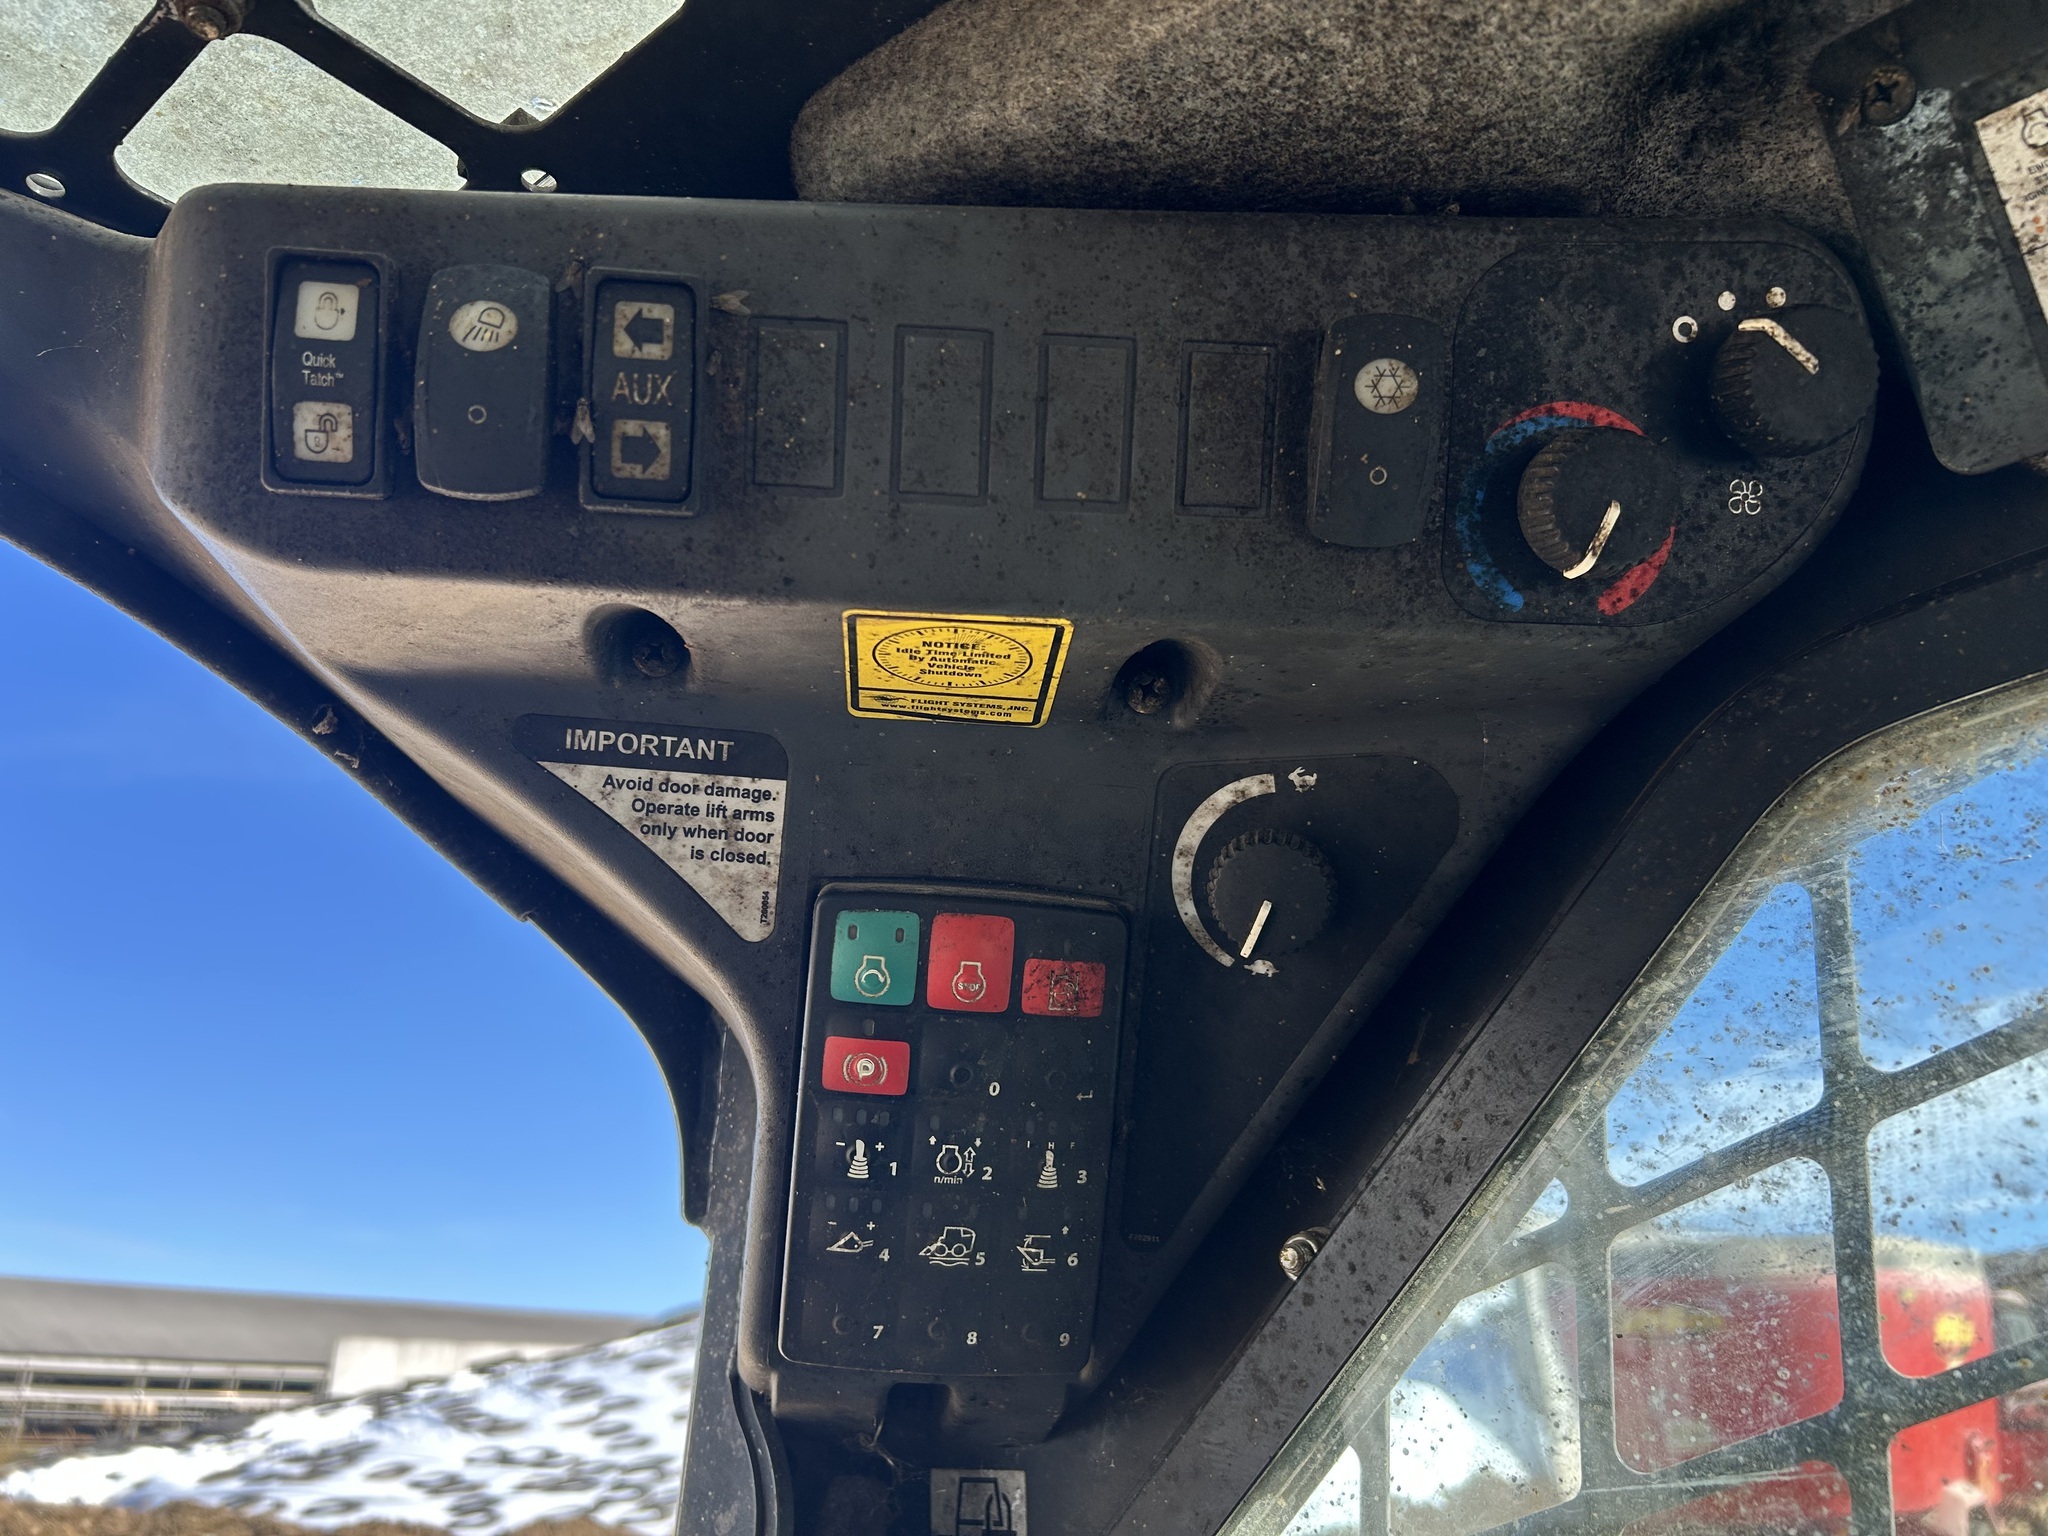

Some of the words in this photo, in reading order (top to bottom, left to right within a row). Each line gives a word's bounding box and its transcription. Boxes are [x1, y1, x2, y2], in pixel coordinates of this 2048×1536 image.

[302, 351, 336, 369] Quick
[612, 371, 675, 406] AUX
[896, 647, 921, 655] Idle
[926, 649, 957, 657] Time
[962, 651, 1011, 660] Limited
[909, 654, 925, 662] By
[929, 656, 997, 666] Automatic
[919, 669, 982, 678] Shutdown
[927, 662, 976, 672] Vehicle
[880, 702, 1012, 718] www.flightsystems.com
[910, 698, 950, 707] FLIGHT
[952, 701, 1005, 711] SYSTEMS,
[565, 728, 735, 762] IMPORTANT
[602, 774, 653, 791] Avoid
[658, 779, 699, 795] door
[704, 783, 777, 803] damage.
[631, 798, 700, 817] Operate
[706, 802, 727, 818] lift
[733, 807, 775, 822] arms
[639, 822, 678, 839] only
[683, 825, 728, 840] when
[734, 829, 774, 844] door
[690, 845, 704, 860] is
[710, 848, 771, 865] closed.
[989, 1082, 1000, 1096] 0
[1048, 1141, 1055, 1150] H
[889, 1162, 897, 1176] 1
[982, 1167, 993, 1181] 2
[934, 1174, 963, 1185] n/min
[1077, 1170, 1087, 1184] 3
[878, 1248, 890, 1262] 4
[975, 1252, 986, 1266] 5
[1067, 1252, 1078, 1267] 6
[872, 1325, 884, 1339] 7
[966, 1331, 978, 1345] 8
[1059, 1333, 1071, 1346] 9
